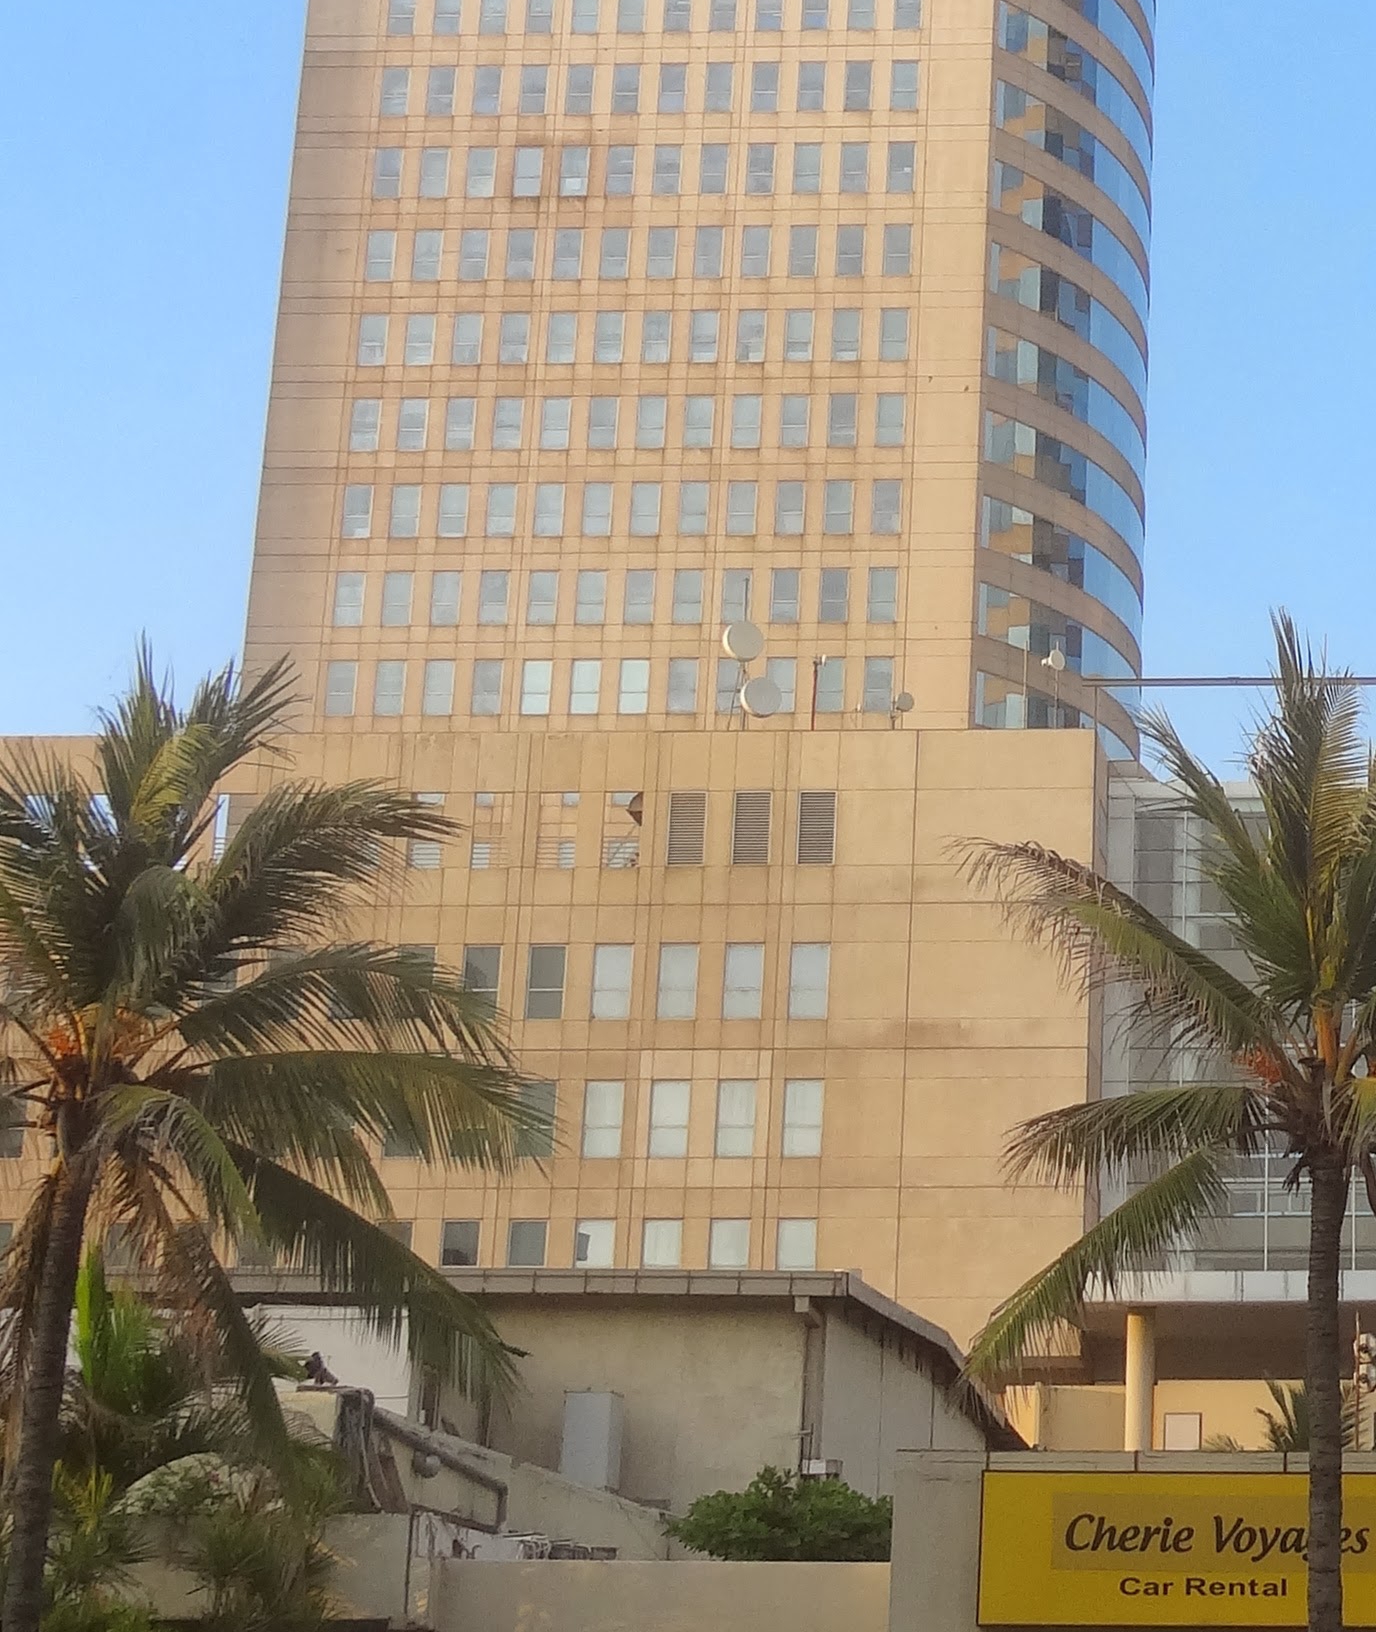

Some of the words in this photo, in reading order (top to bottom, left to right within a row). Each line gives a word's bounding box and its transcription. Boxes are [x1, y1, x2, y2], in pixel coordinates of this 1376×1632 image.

[1065, 1513, 1195, 1553] Cherie
[1213, 1515, 1370, 1563] Voyaes
[1119, 1577, 1174, 1597] Car
[1185, 1576, 1289, 1597] Rental
